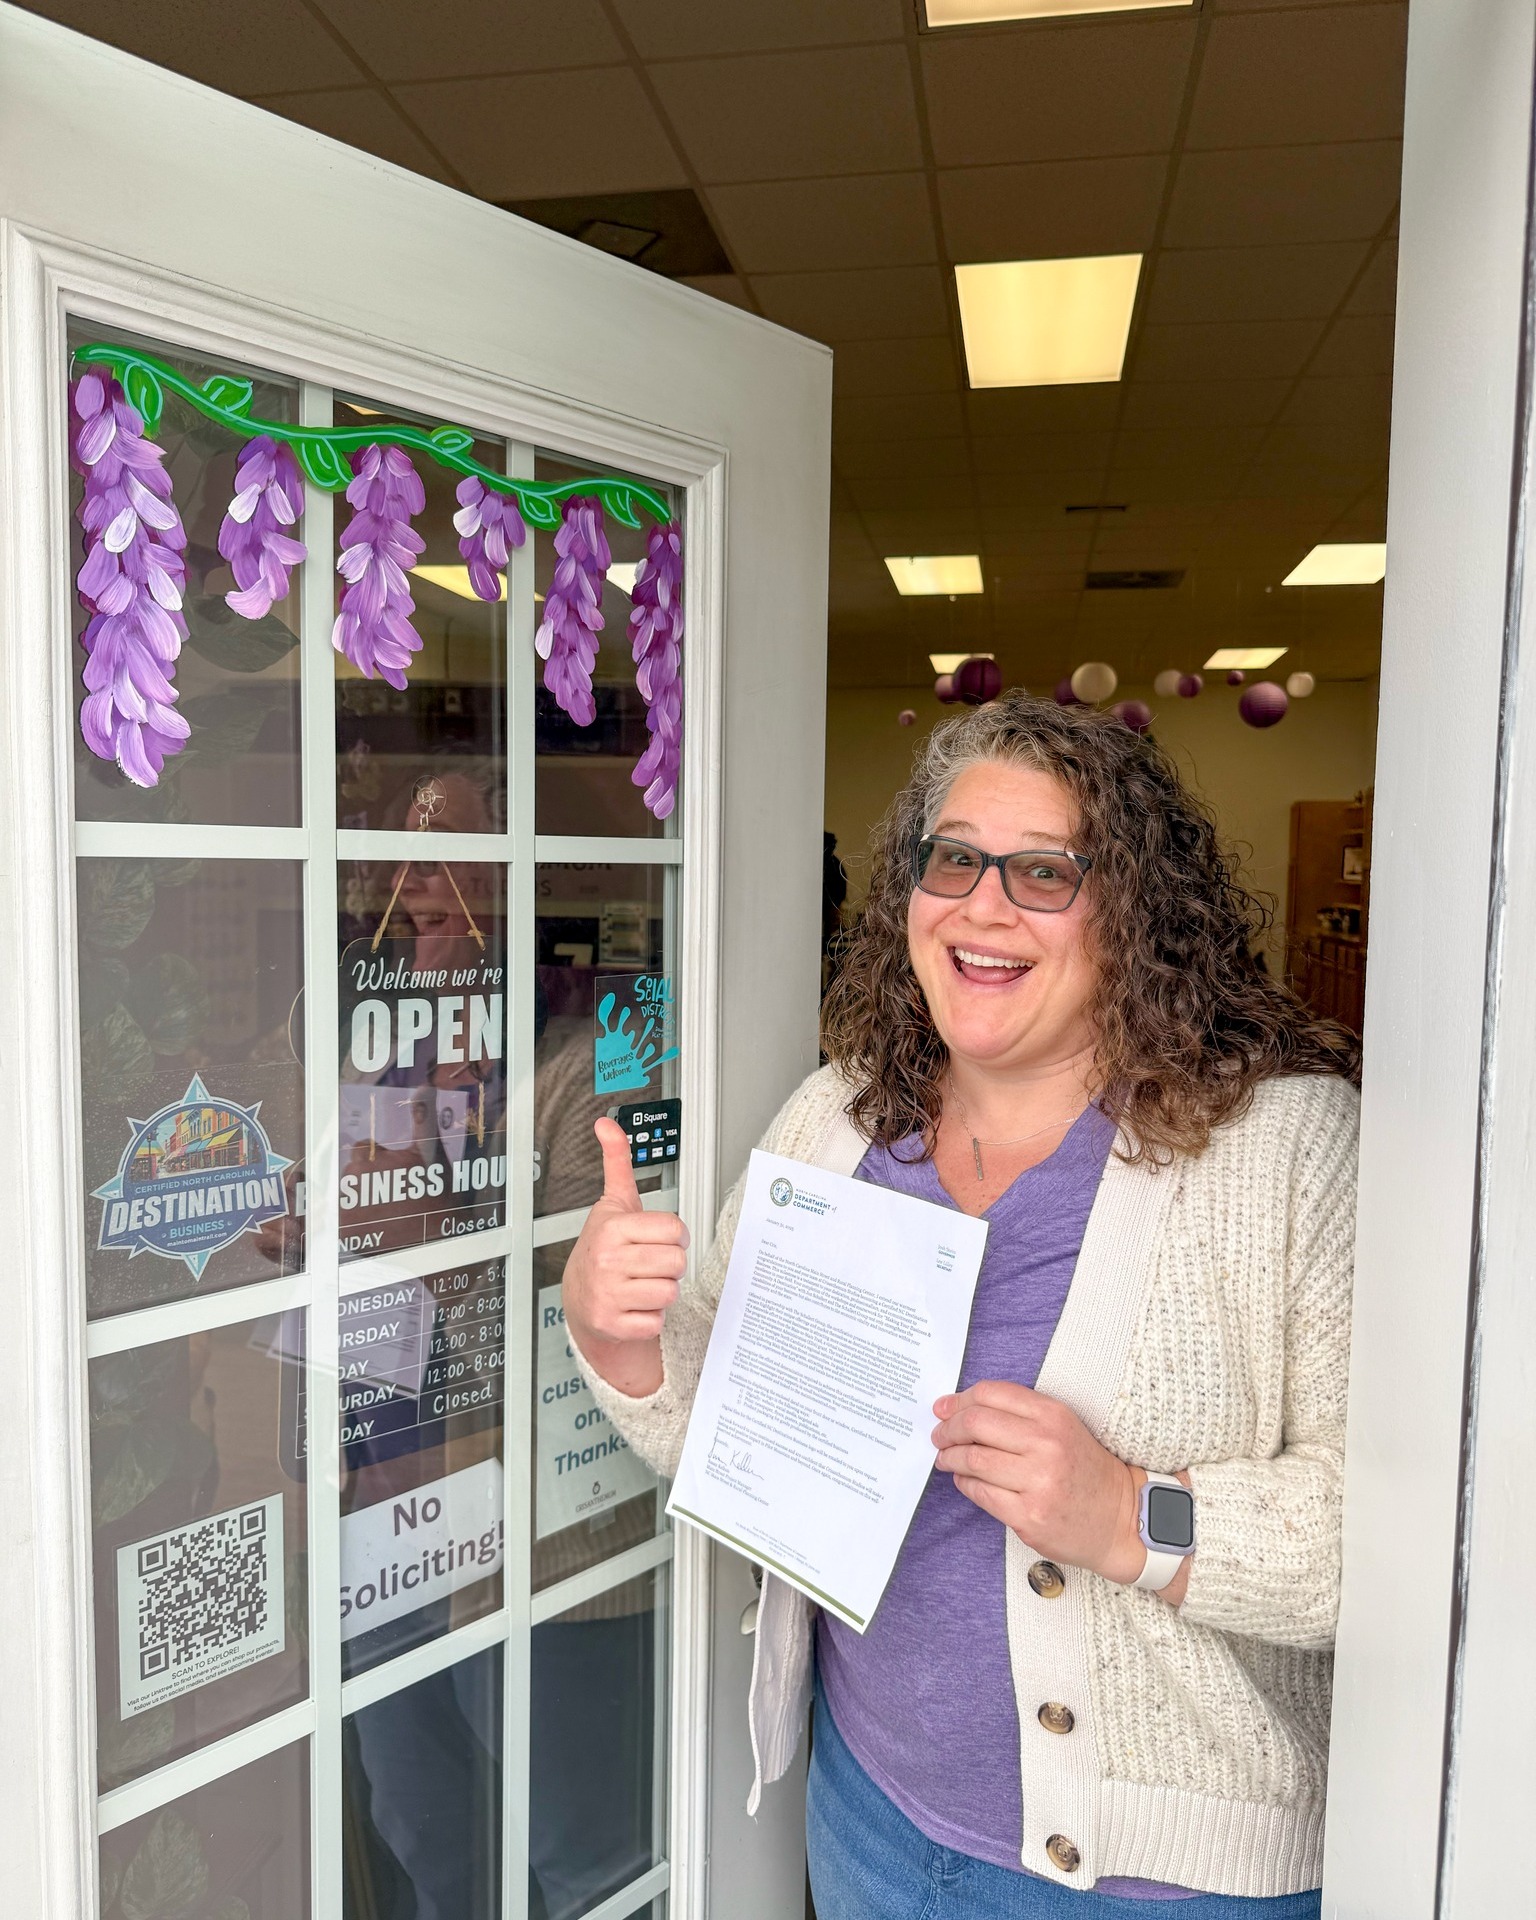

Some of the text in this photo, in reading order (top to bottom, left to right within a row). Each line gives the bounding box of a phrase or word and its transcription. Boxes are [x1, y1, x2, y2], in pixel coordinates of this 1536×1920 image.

[352, 957, 502, 992] Welcome we're
[352, 994, 502, 1073] OPEN
[598, 1052, 634, 1073] Beverages
[603, 1065, 632, 1081] Welcome
[644, 1113, 668, 1123] Square
[135, 1168, 256, 1194] CERTIFIED NORTH CAROLINA
[452, 1150, 542, 1193] HOUS
[108, 1177, 280, 1236] DESTINATION
[792, 1200, 825, 1216] COMMERCE
[794, 1193, 830, 1210] DEPARTMENT
[167, 1232, 227, 1246] maintomaintrail.com
[170, 1220, 225, 1238] BUSINESS
[338, 1208, 498, 1251] NDAY Closed
[338, 1287, 416, 1316] DNESDAY
[434, 1274, 468, 1294] 12:00
[338, 1321, 400, 1348] RSDAY
[432, 1304, 466, 1323] 12:00
[477, 1296, 505, 1313] 8:00
[338, 1360, 368, 1380] DAY
[431, 1333, 466, 1354] 12:00
[479, 1323, 505, 1342] 8:0
[428, 1363, 464, 1384] 12:00
[475, 1350, 506, 1372] 8:00
[433, 1382, 492, 1414] Closed
[394, 1497, 441, 1536] No
[341, 1520, 504, 1620] Soliciting!
[127, 1697, 139, 1706] Visit
[141, 1693, 150, 1701] our
[151, 1685, 173, 1696] Linktree
[192, 1669, 209, 1679] where
[210, 1665, 220, 1673] you
[232, 1653, 245, 1662] shop
[172, 1646, 239, 1680] SCAN TO EXPLORE!
[134, 1701, 151, 1711] follow
[169, 1686, 185, 1696] social
[205, 1672, 217, 1680] and
[228, 1657, 254, 1671] upcoming
